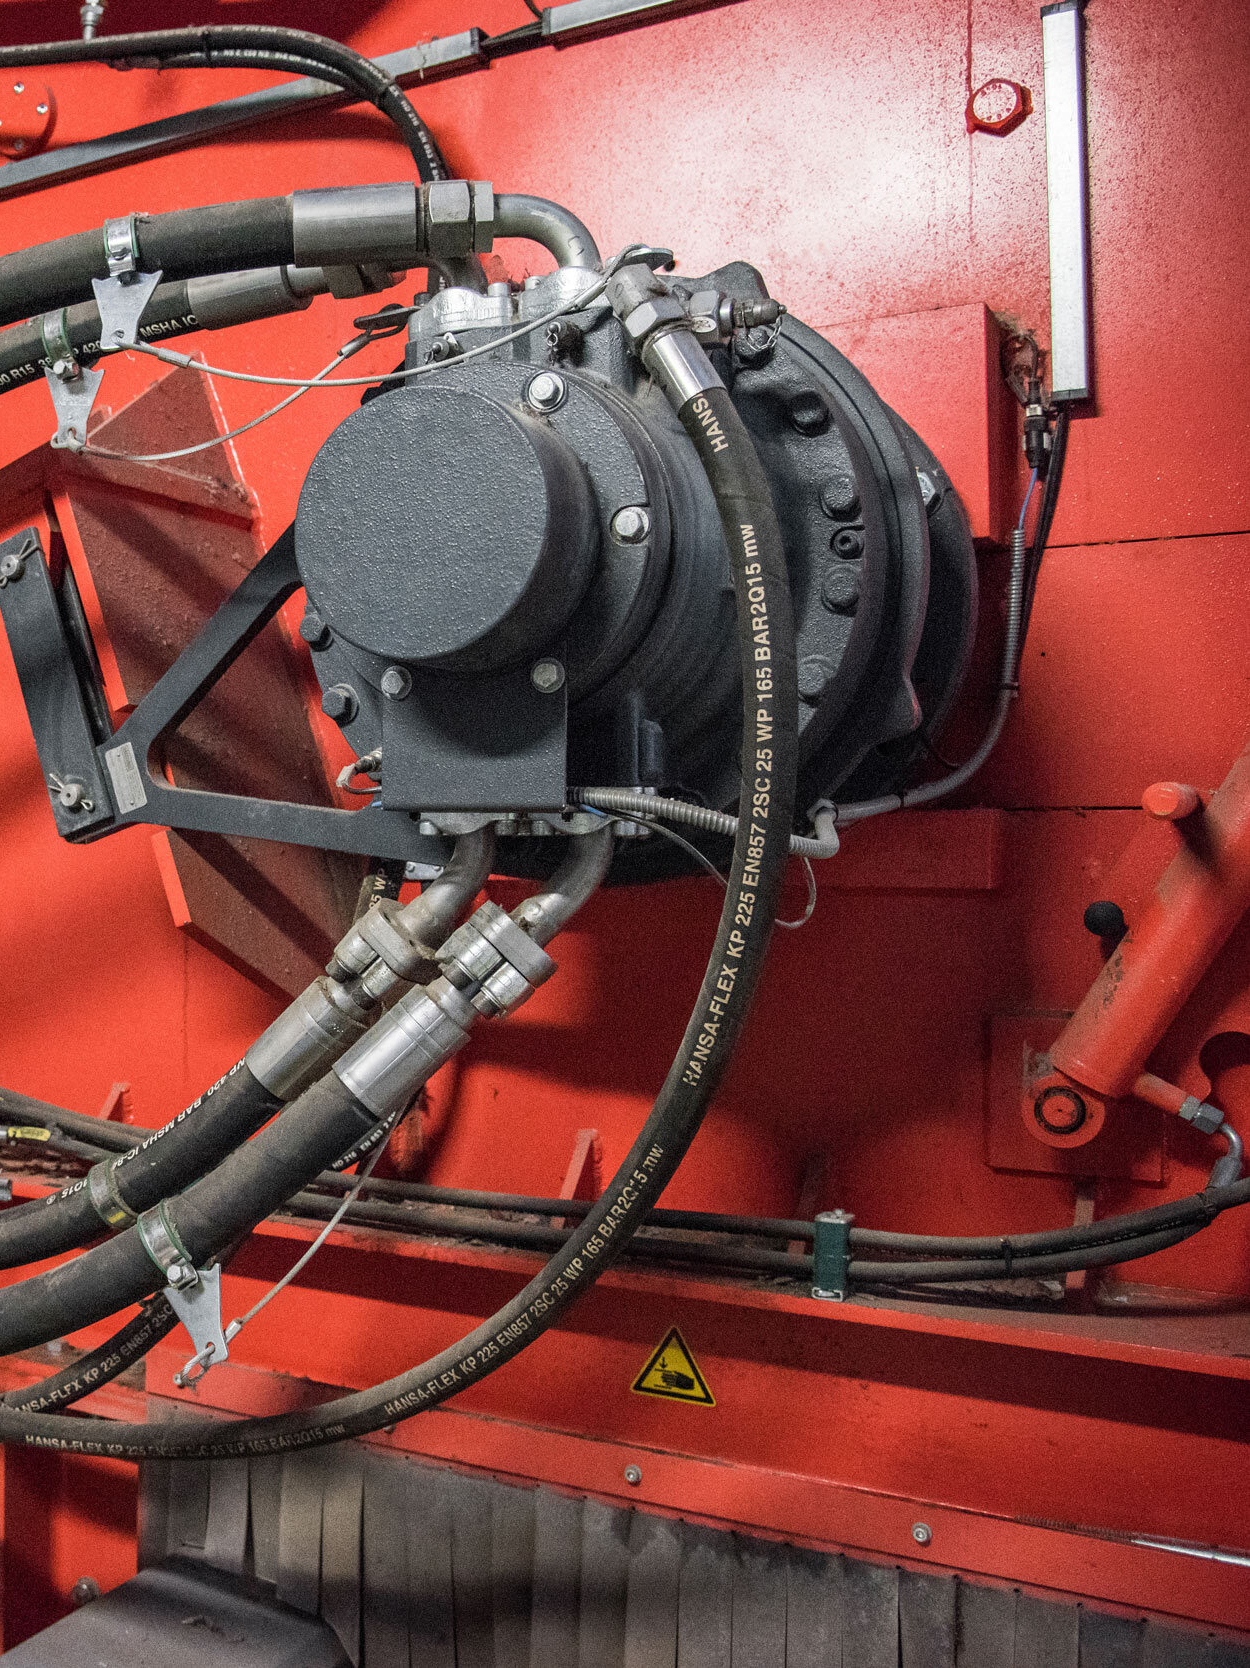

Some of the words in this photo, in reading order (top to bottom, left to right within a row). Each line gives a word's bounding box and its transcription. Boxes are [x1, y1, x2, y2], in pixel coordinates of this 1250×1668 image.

[12, 364, 35, 380] R15
[140, 319, 182, 338] MSHA
[692, 391, 729, 453] HANS
[740, 523, 762, 558] mw
[744, 561, 772, 661] BAR2Q15
[755, 665, 773, 702] 165
[756, 709, 774, 745] WP
[755, 747, 773, 773] 25
[752, 776, 771, 819] 2SC
[743, 822, 768, 888] EN857
[735, 891, 756, 928] 225
[727, 929, 746, 959] KP
[682, 963, 738, 1087] HANSA-FLEX
[177, 1097, 202, 1122] BAR
[142, 1120, 175, 1149] MSHA
[383, 1367, 461, 1417] HANSA-FLEX
[459, 1356, 477, 1376] KP
[476, 1341, 499, 1364] 225
[497, 1314, 532, 1348] EN857
[530, 1291, 556, 1318] 2SC
[550, 1277, 570, 1297] 25
[563, 1256, 586, 1282] WP
[581, 1235, 605, 1264] 165
[597, 1170, 648, 1240] BAR2Q15
[643, 1143, 665, 1172] mw
[83, 1368, 99, 1383] KP
[100, 1353, 121, 1373] 225
[25, 1434, 104, 1453] HANSA-FLEX
